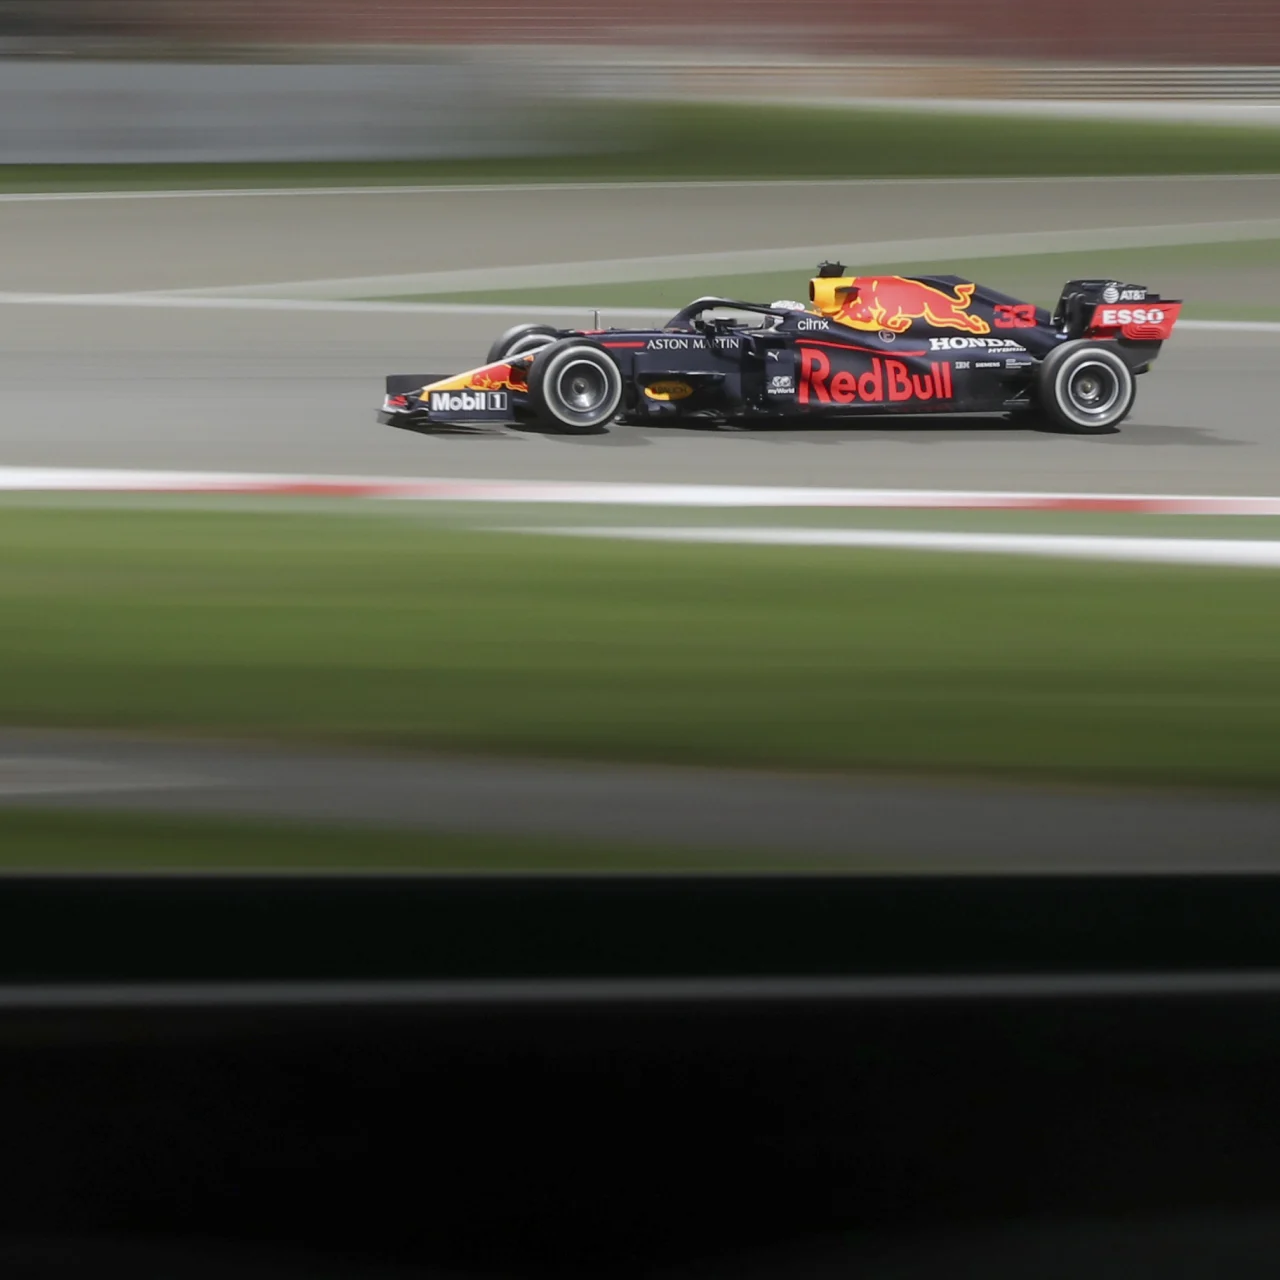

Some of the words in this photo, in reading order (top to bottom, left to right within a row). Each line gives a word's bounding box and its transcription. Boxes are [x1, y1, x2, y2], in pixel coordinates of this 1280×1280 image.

[1119, 290, 1147, 300] AT&T
[993, 304, 1038, 328] 33
[1102, 309, 1164, 324] ESSO
[797, 318, 829, 330] citrix
[646, 338, 688, 349] ASTON
[692, 338, 739, 349] MARTIN
[929, 337, 1024, 351] HONDA
[955, 361, 970, 369] IBM
[431, 392, 486, 411] Mobil
